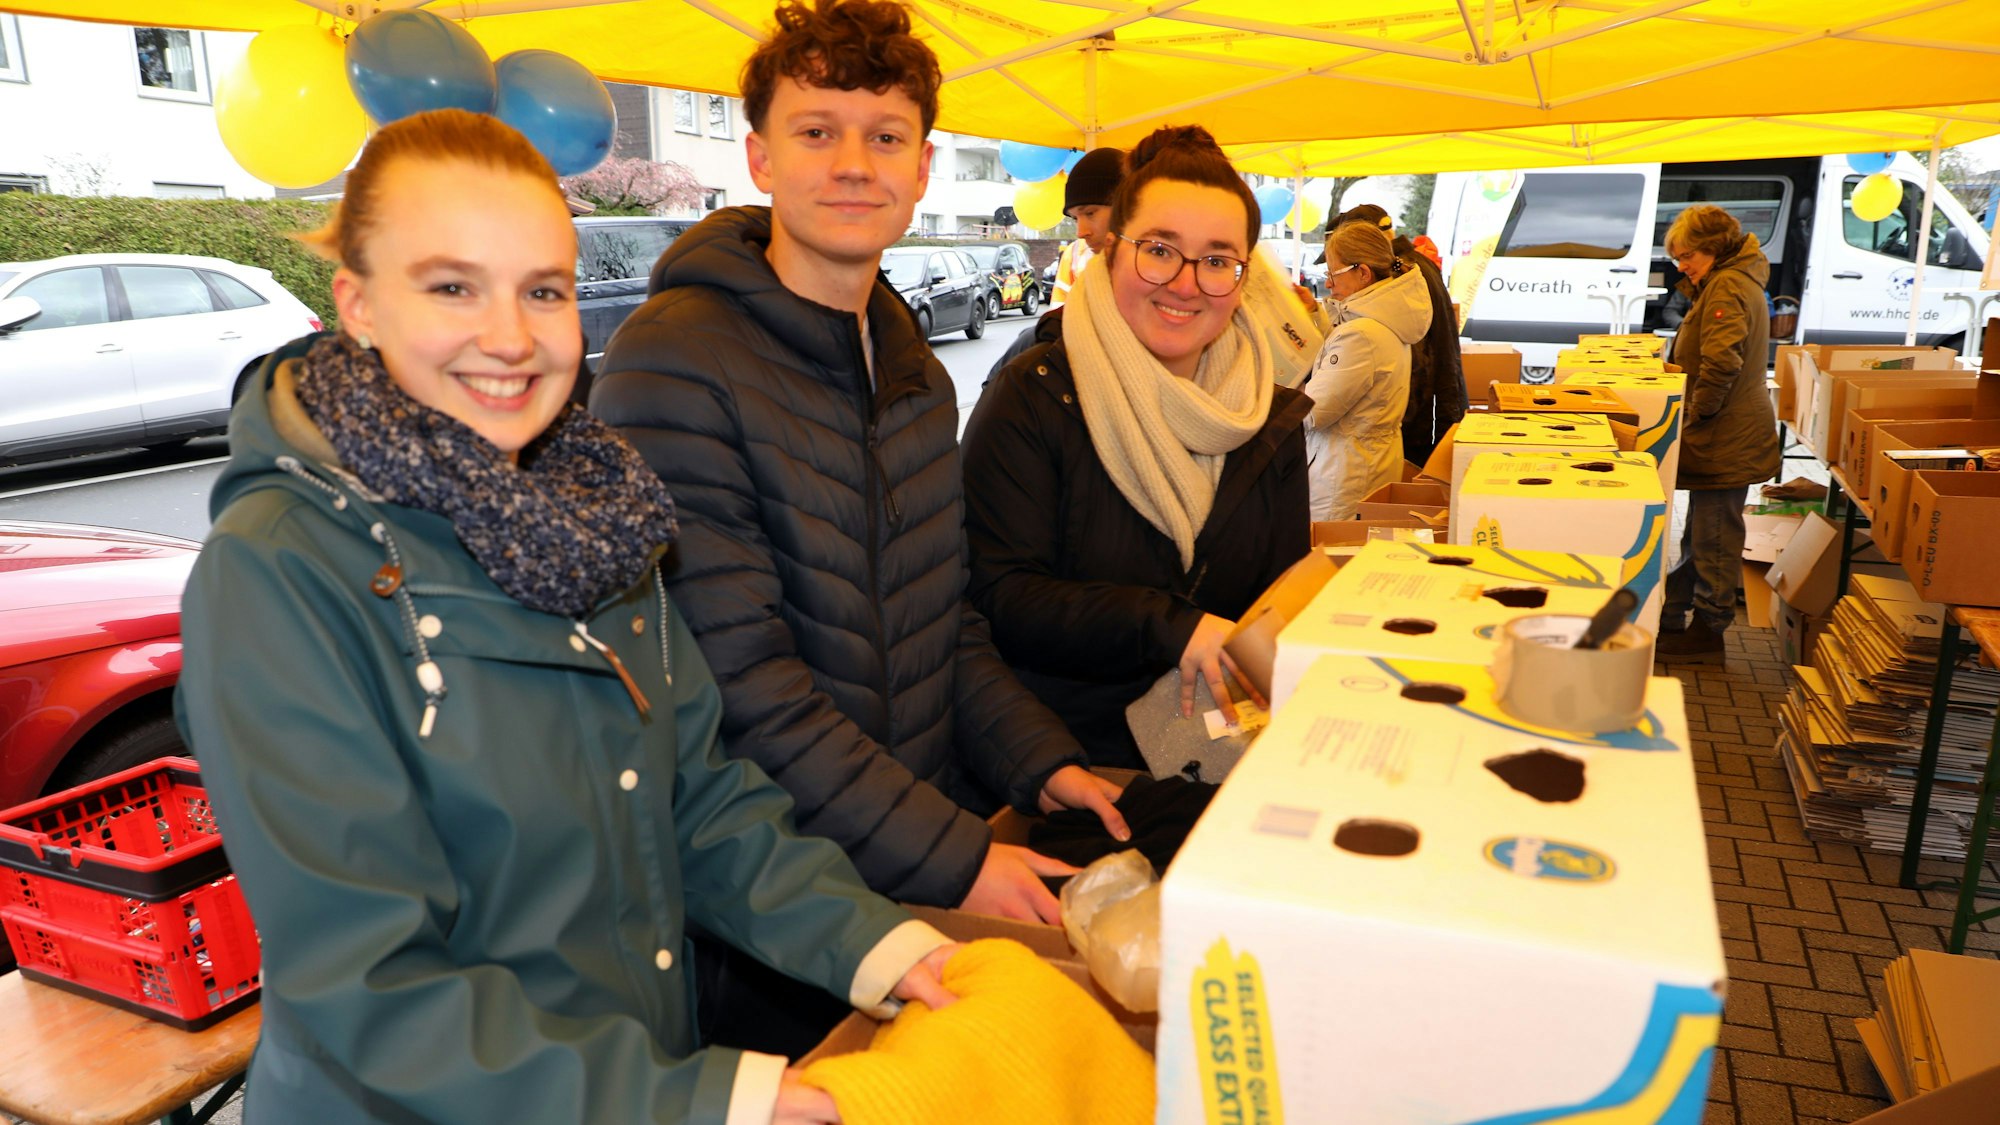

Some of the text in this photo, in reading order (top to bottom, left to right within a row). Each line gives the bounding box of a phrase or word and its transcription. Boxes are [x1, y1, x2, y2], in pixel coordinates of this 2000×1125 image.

[1489, 277, 1572, 294] Overath
[1476, 531, 1488, 547] CL
[1489, 525, 1500, 549] SELE
[1236, 972, 1264, 1073] SELECTED
[1202, 978, 1244, 1125] CLASS EXT
